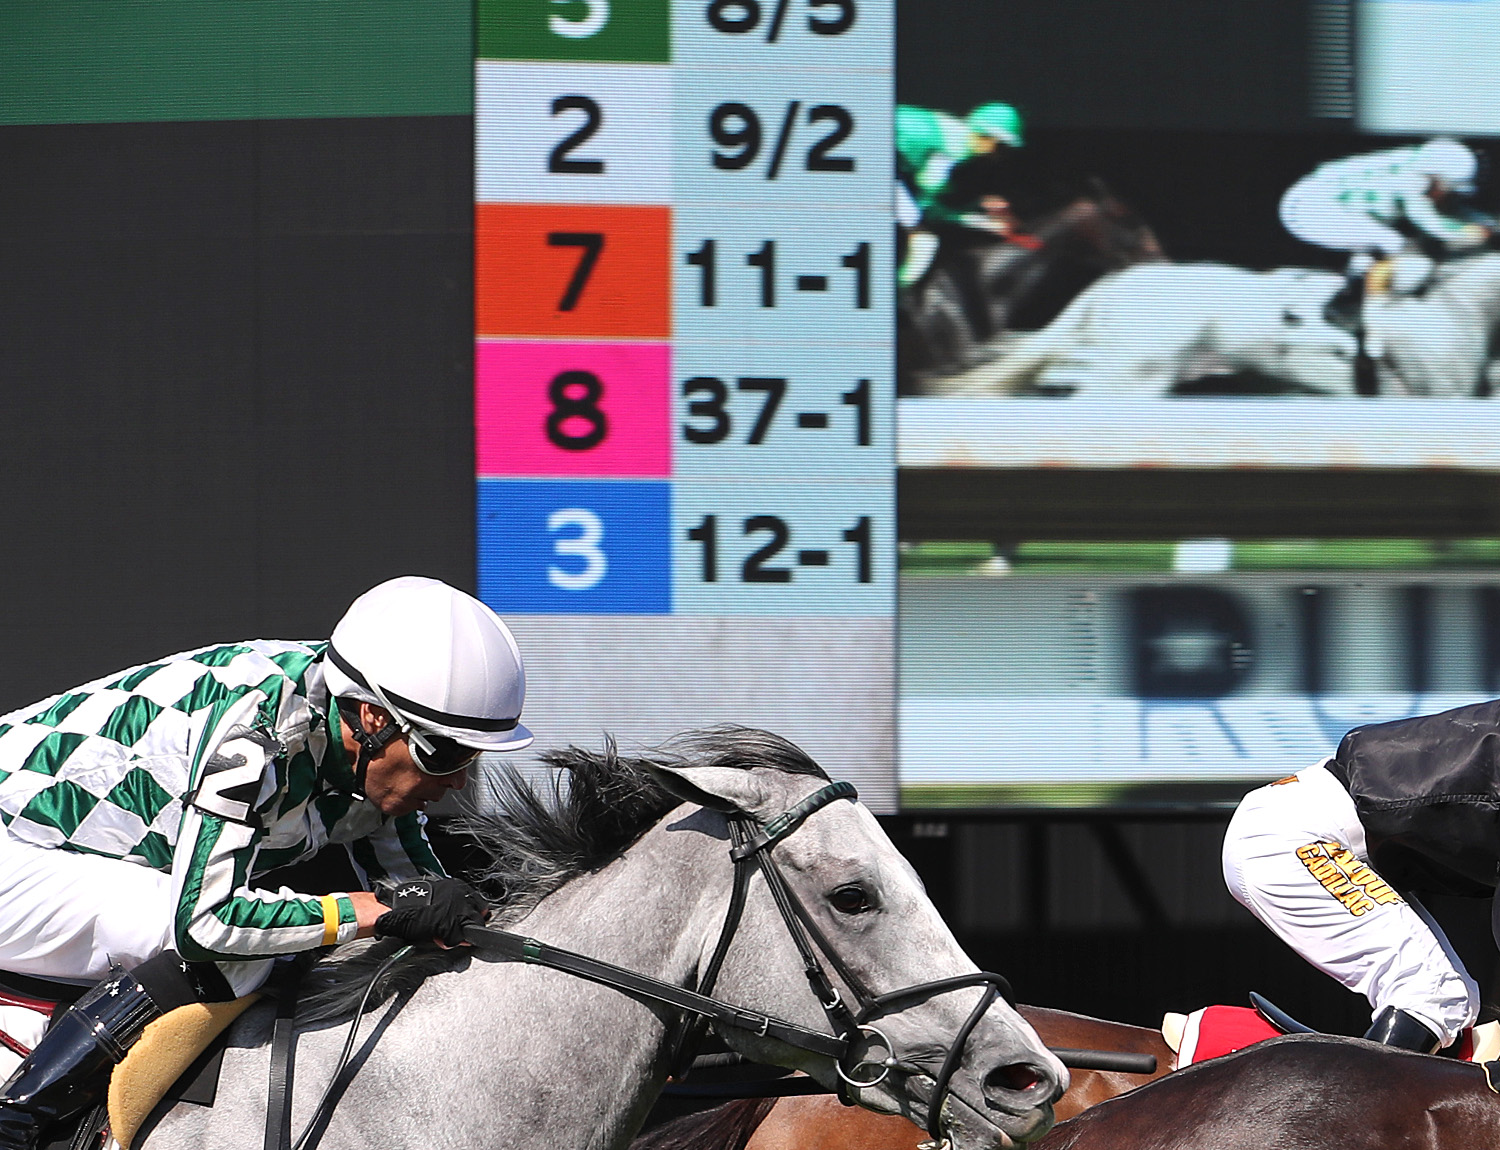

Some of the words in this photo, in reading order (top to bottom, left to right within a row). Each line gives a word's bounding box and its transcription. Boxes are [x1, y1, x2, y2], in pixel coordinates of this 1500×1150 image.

[547, 94, 606, 174] 2
[708, 100, 856, 181] 9/2
[545, 232, 606, 312] 7
[686, 238, 872, 309] 11-1
[544, 370, 610, 451] 8
[681, 376, 872, 447] 37-1
[546, 508, 608, 591] 3
[687, 514, 872, 584] 12-1
[193, 736, 266, 822] 2
[1295, 843, 1375, 917] CADILLAC
